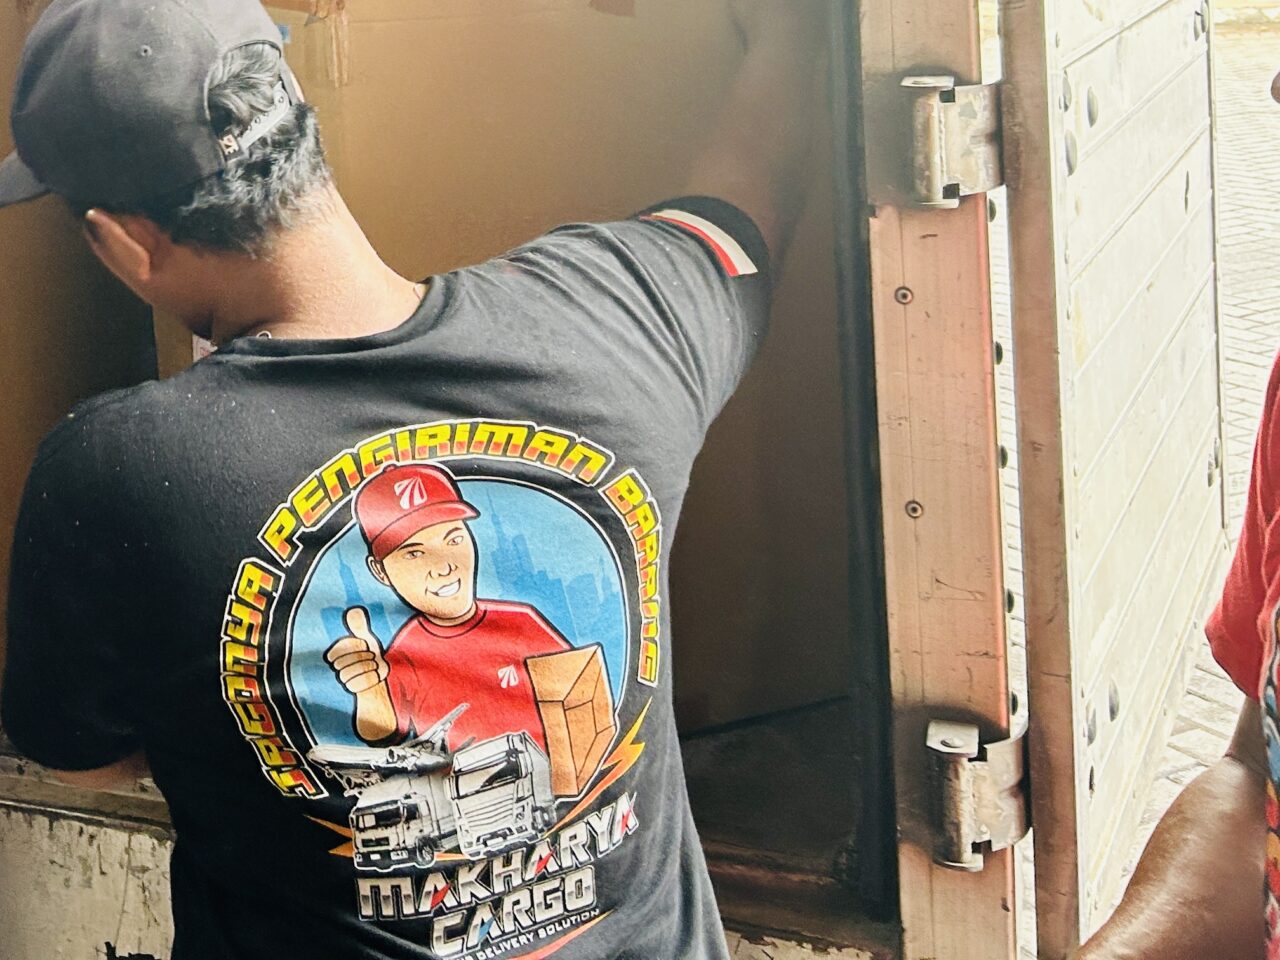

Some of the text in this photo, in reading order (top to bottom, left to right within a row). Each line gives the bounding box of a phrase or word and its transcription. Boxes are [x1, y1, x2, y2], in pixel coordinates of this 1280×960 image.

[260, 421, 610, 562] PENGIRIMAN
[602, 472, 661, 685] BARANG
[356, 791, 640, 920] MAKHARYA
[430, 865, 597, 957] CARGO
[476, 908, 600, 960] DELIVERY SOLUTION
